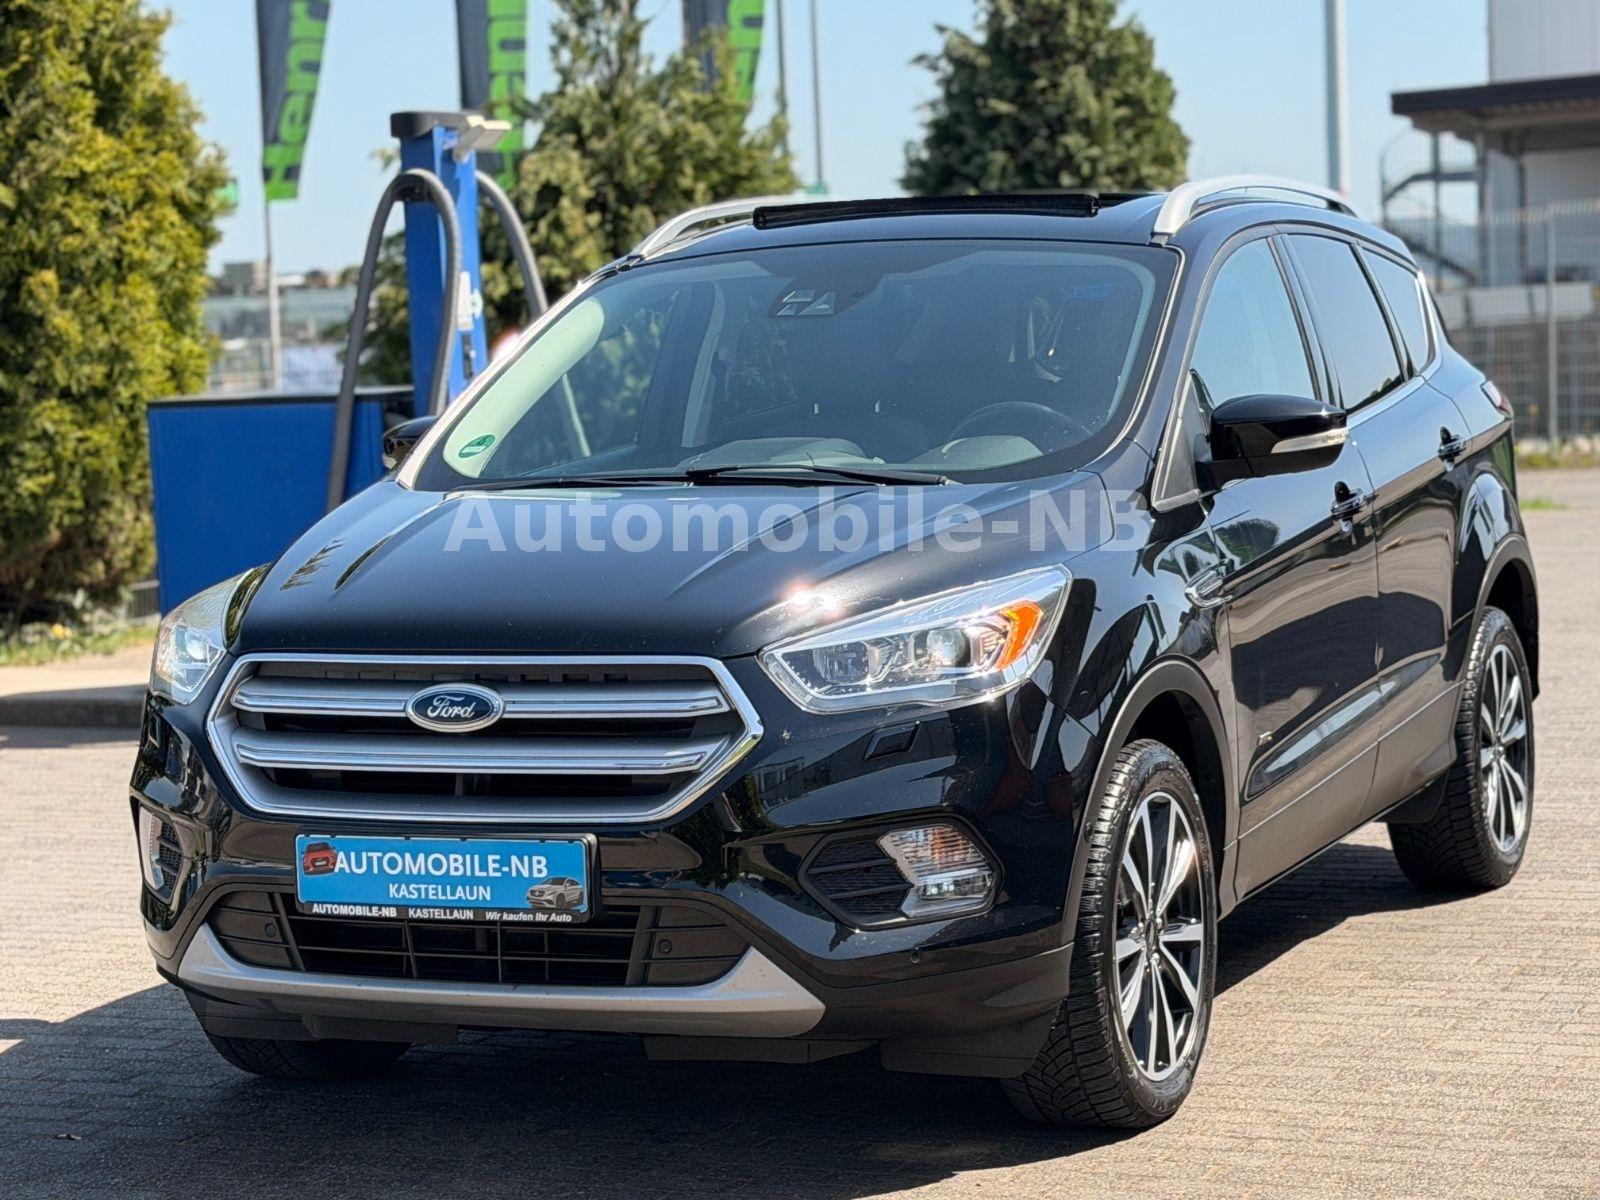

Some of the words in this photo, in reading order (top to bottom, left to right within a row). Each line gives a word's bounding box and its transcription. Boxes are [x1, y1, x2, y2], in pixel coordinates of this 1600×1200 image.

[264, 0, 329, 201] Henr
[427, 695, 477, 718] Ford
[334, 850, 549, 878] AUTOMOBILE-NB
[389, 883, 491, 901] KASTELLAUN
[312, 903, 397, 918] AUTOMOBILE-NB
[408, 907, 474, 920] KASTELLAUN
[485, 910, 502, 921] Wir
[503, 911, 534, 922] kaufen
[535, 912, 549, 922] Ihr
[549, 913, 572, 922] Auto
